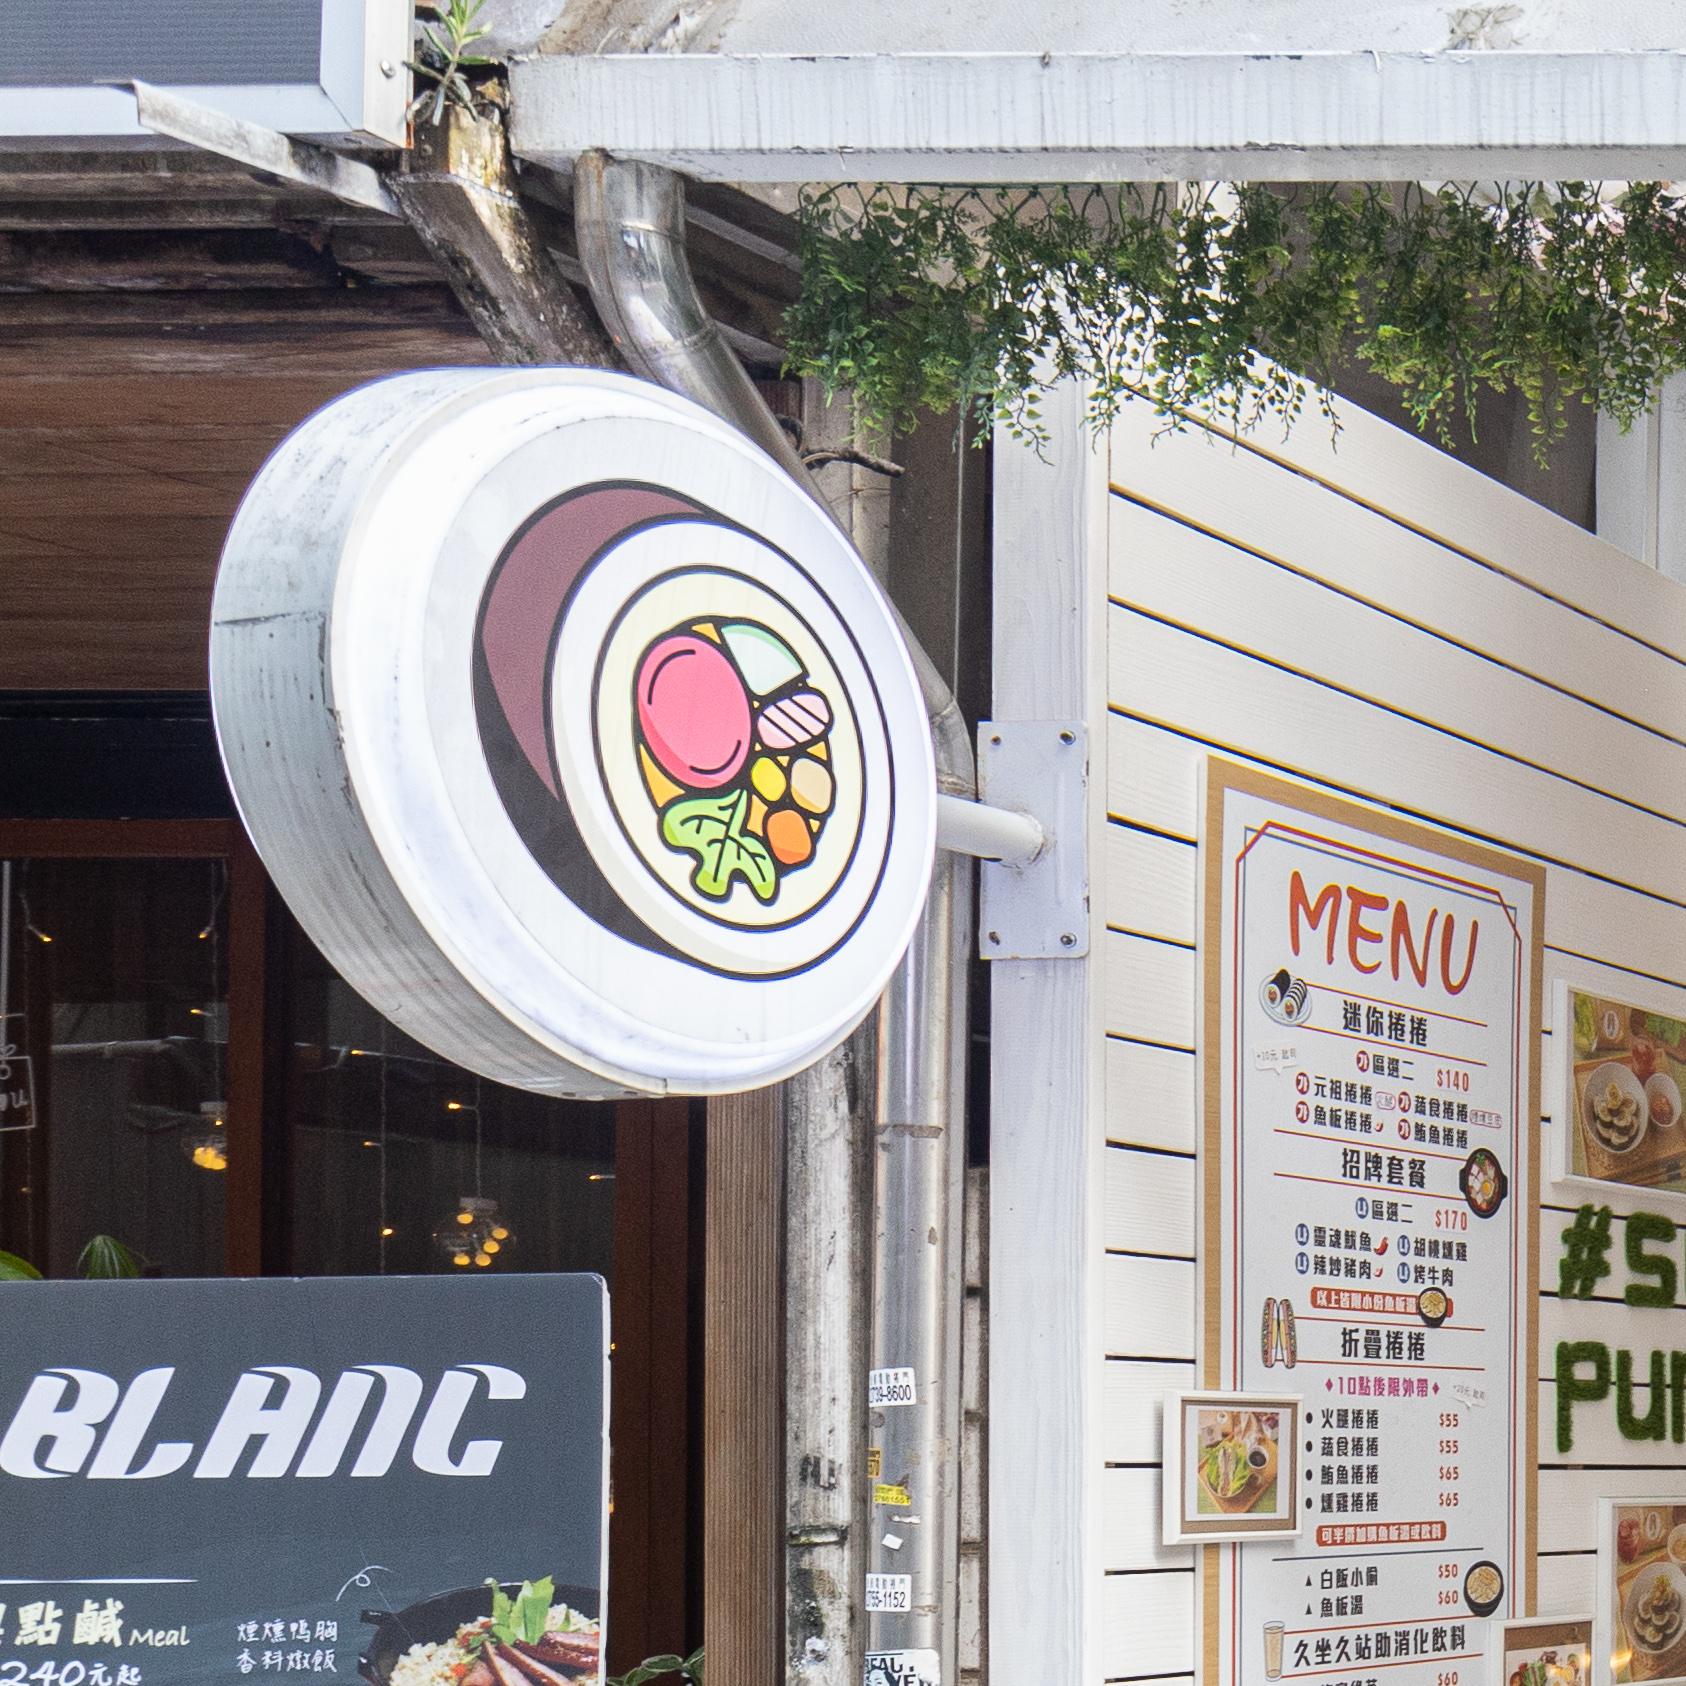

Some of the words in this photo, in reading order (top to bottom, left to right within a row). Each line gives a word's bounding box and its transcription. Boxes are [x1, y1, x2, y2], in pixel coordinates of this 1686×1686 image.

[1289, 870, 1478, 995] MENU
[1342, 1000, 1428, 1047] 迷你捲捲
[1314, 1075, 1372, 1106] 元祖捲捲
[1437, 1069, 1469, 1092] $140
[1342, 1148, 1426, 1189] 招牌套餐
[1435, 1209, 1467, 1231] $170
[1414, 1264, 1453, 1287] 烤牛肉
[1341, 1327, 1425, 1361] 折疊捲捲
[0, 1364, 527, 1479] BLANC
[1439, 1413, 1459, 1427] $55
[1439, 1440, 1459, 1454] $55
[1439, 1466, 1459, 1481] $65
[1439, 1492, 1459, 1507] $65
[1320, 1566, 1378, 1589] 白飯小偷
[1438, 1564, 1458, 1579] $50
[1320, 1594, 1363, 1618] 魚板湯
[1438, 1590, 1458, 1605] $60
[0, 1598, 125, 1647] 點鹹
[129, 1626, 190, 1647] Meal
[237, 1619, 338, 1643] 煙燻鴨胸
[1294, 1625, 1465, 1667] 久坐久站助消化飲料
[236, 1649, 338, 1674] 香料燉飯
[1437, 1672, 1458, 1686] $60
